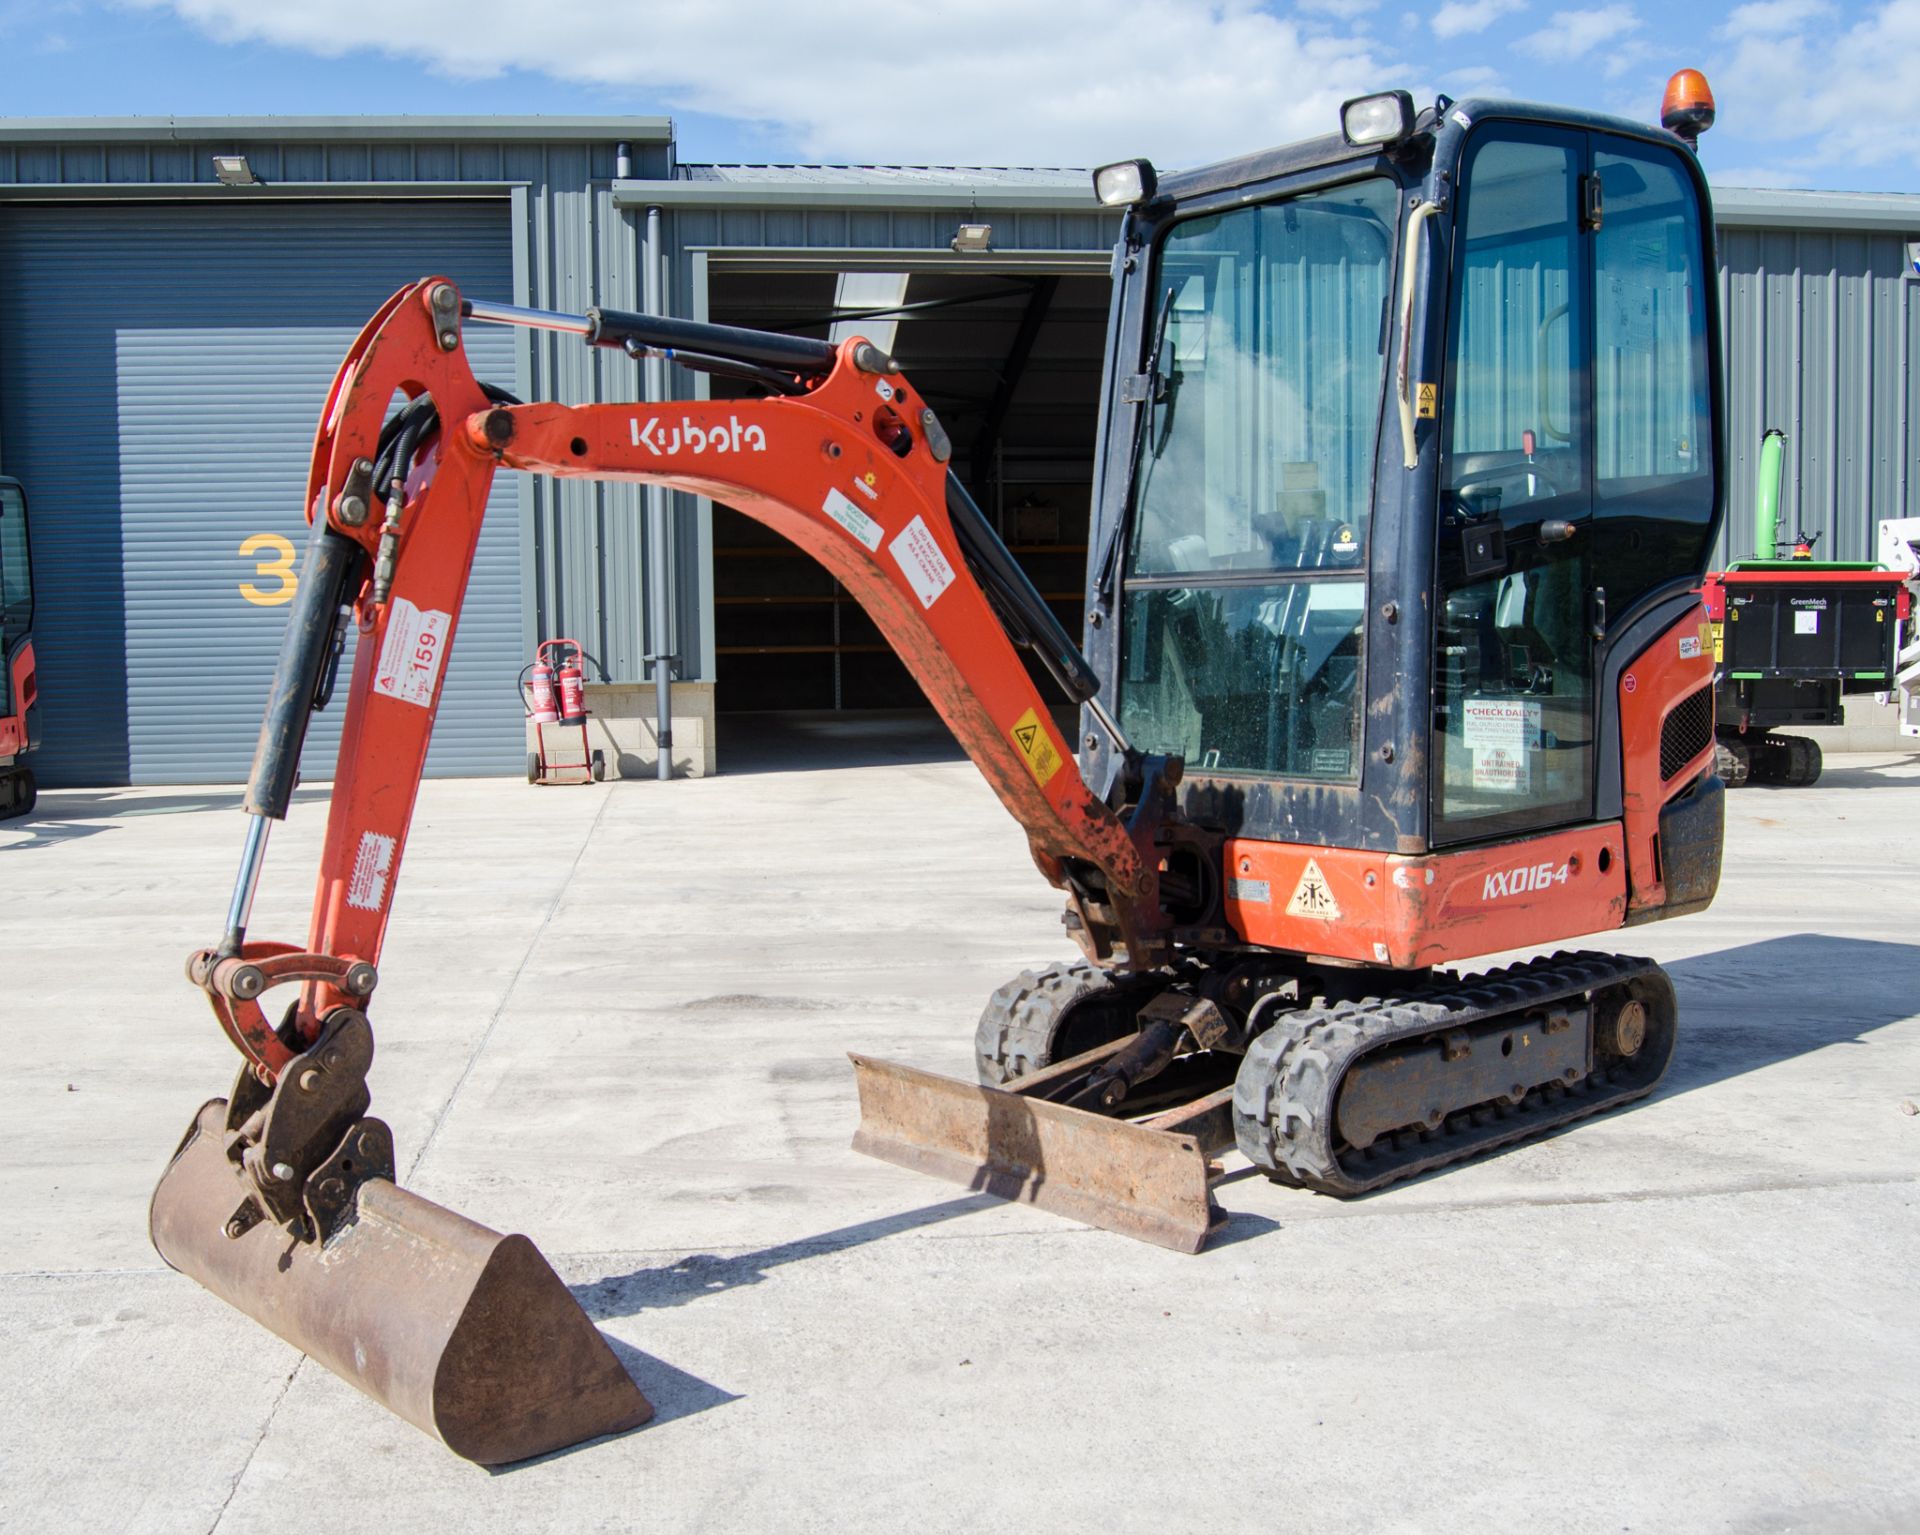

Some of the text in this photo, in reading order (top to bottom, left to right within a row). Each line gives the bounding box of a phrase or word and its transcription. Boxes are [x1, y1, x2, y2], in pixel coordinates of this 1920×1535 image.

[630, 415, 767, 456] Kubota
[239, 533, 298, 606] 3
[908, 527, 945, 587] THIS EXCAVATOR
[918, 528, 946, 573] DO NOT USE
[918, 558, 934, 583] CRANE
[413, 633, 436, 671] 159
[1472, 708, 1533, 717] CHECK DAILY
